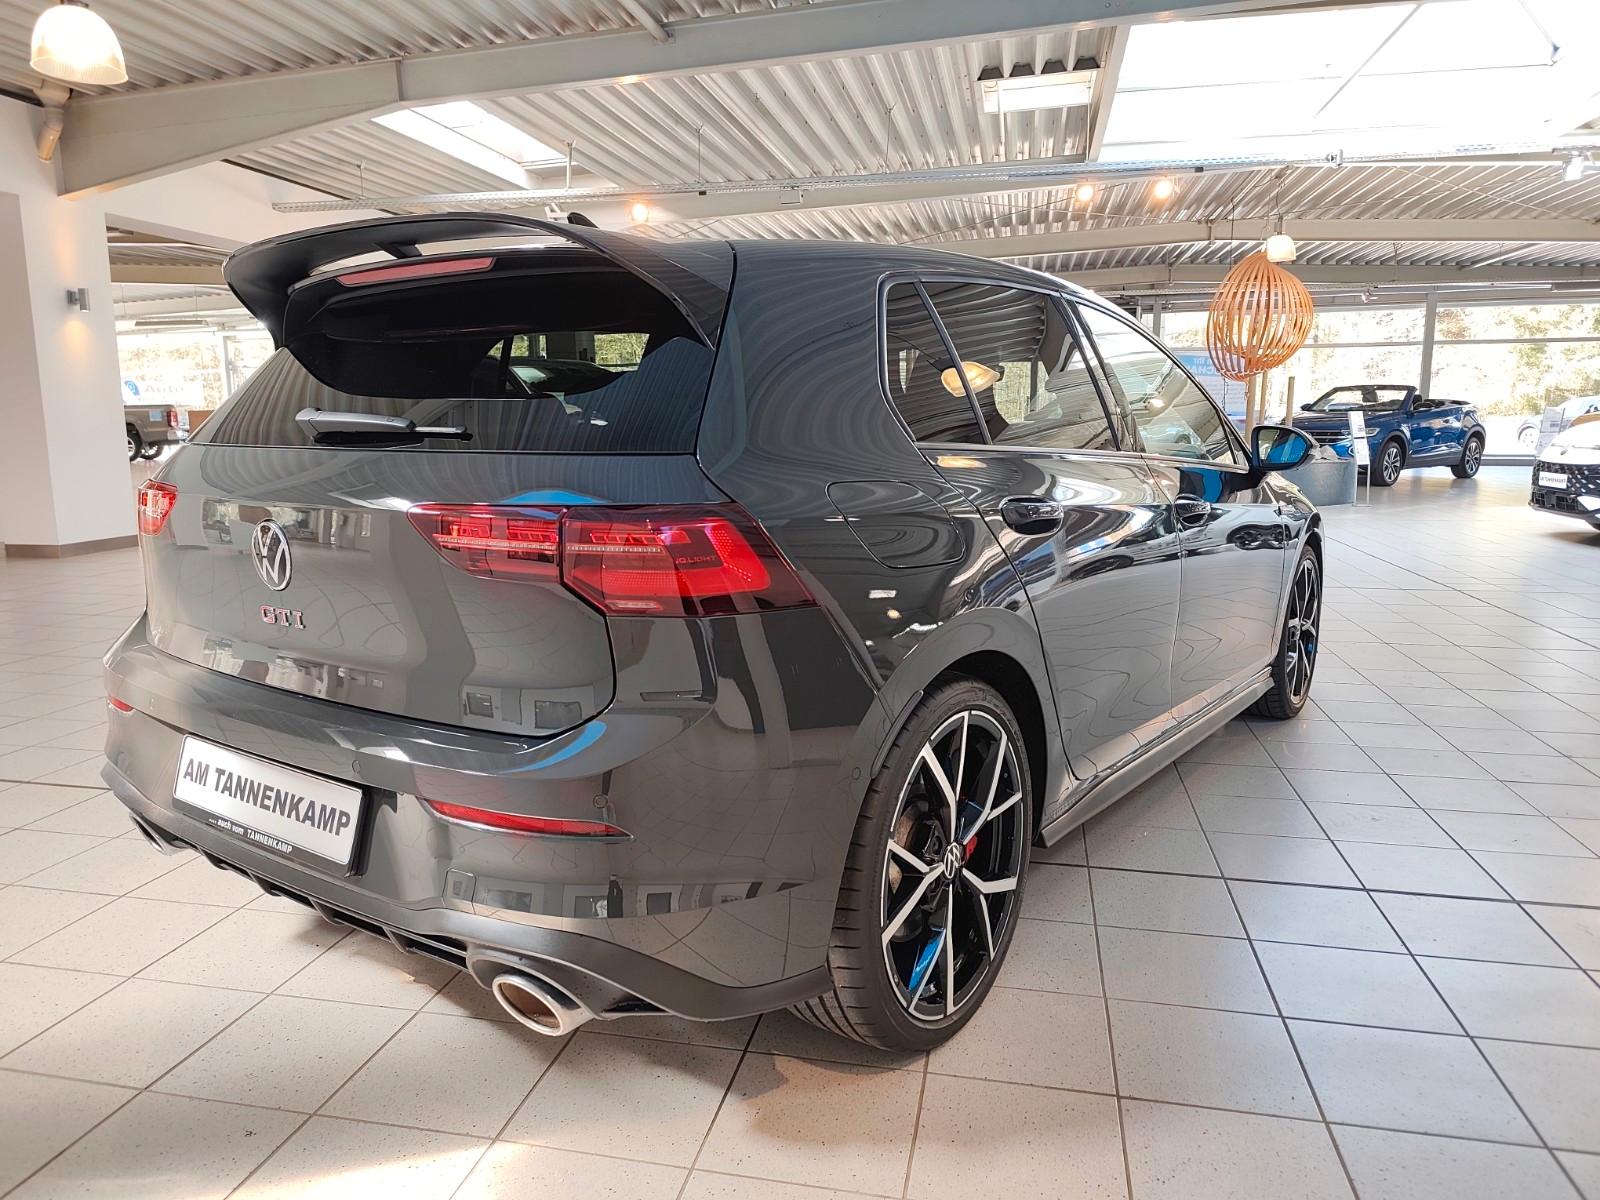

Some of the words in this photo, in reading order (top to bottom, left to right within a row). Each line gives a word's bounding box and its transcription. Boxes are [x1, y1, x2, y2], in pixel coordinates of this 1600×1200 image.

[260, 605, 306, 630] GTI
[183, 758, 210, 787] AM
[214, 768, 351, 836] TANNENKAMP
[247, 829, 293, 854] TANNENKAMP
